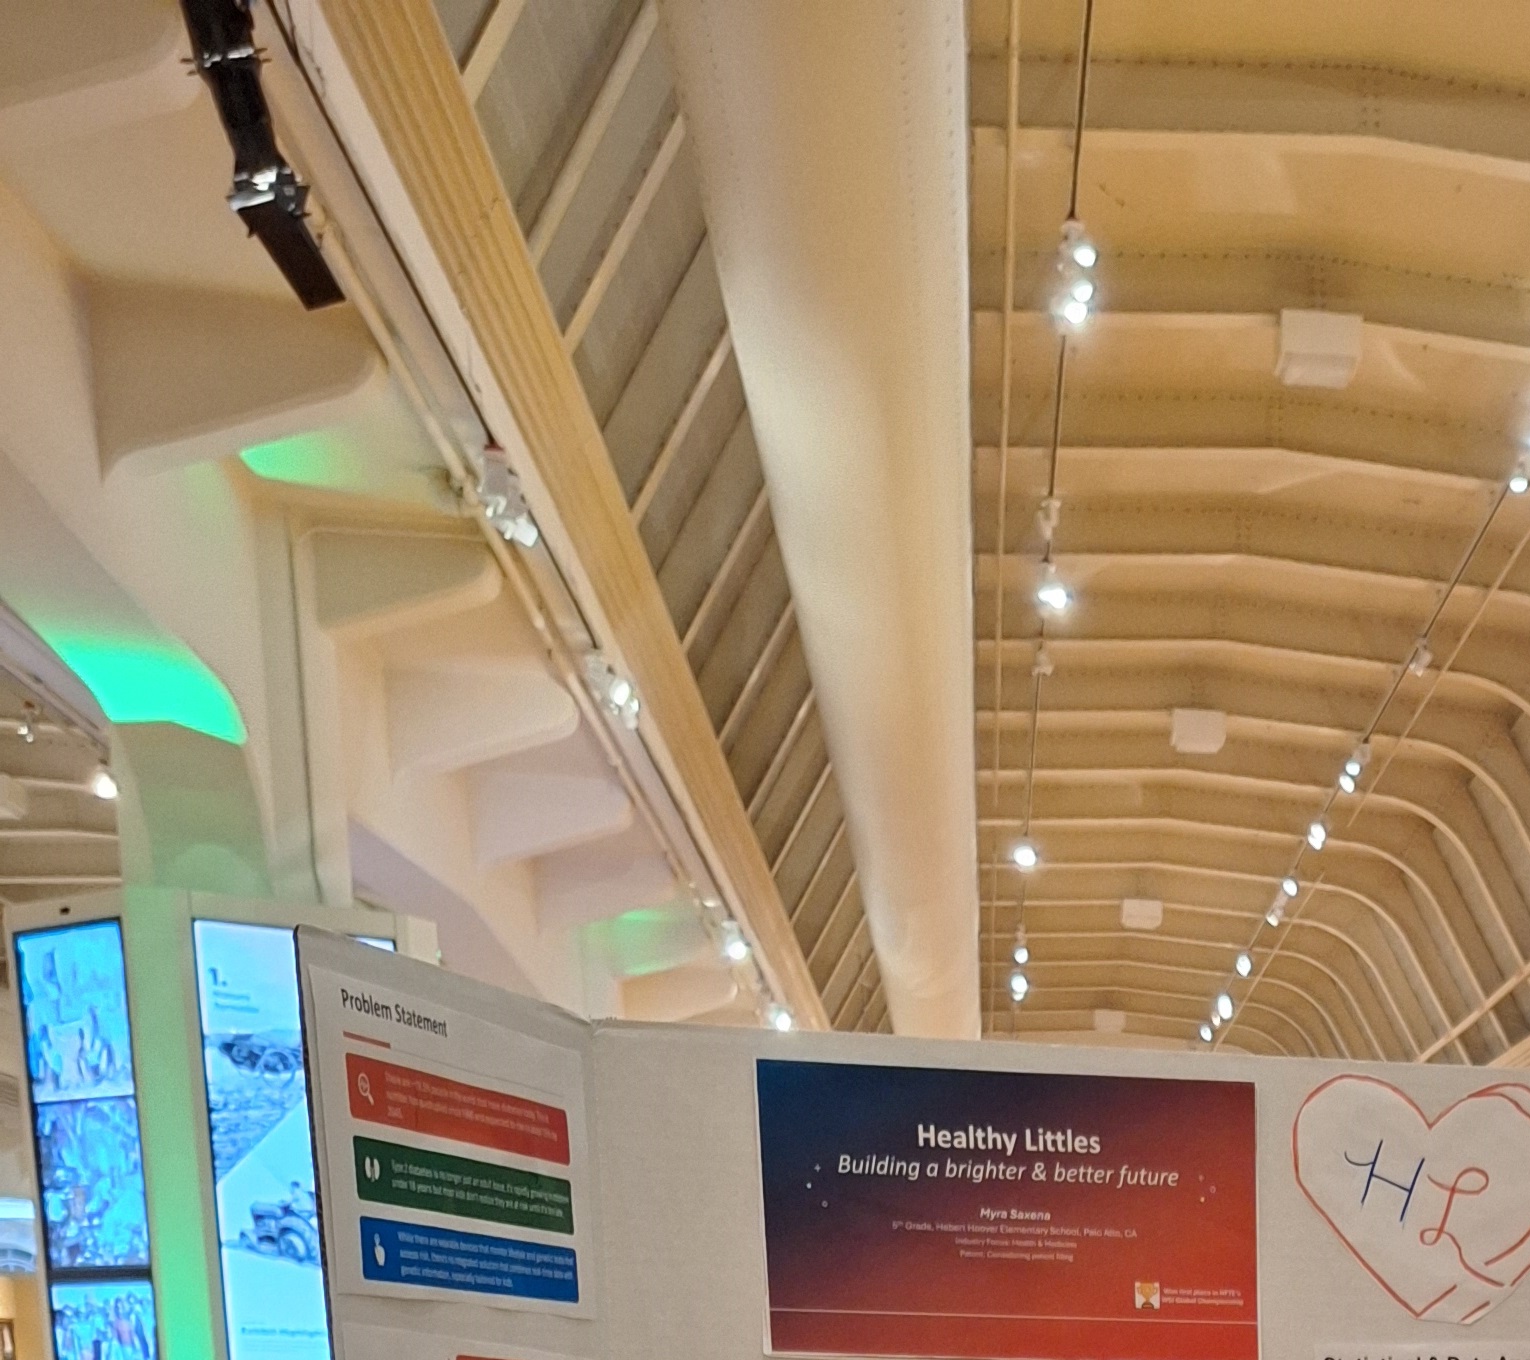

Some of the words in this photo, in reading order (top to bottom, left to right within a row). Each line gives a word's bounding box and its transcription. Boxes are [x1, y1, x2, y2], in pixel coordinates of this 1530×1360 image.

[341, 988, 392, 1022] Problem
[395, 1004, 448, 1038] Statement
[917, 1123, 1017, 1156] Healthy
[1025, 1128, 1101, 1154] Littles
[837, 1154, 920, 1181] Building
[926, 1162, 939, 1177] a
[945, 1158, 1026, 1183] brighter
[1031, 1162, 1047, 1182] &
[1054, 1162, 1114, 1184] better
[1116, 1164, 1180, 1188] future
[980, 1207, 1008, 1222] Myra
